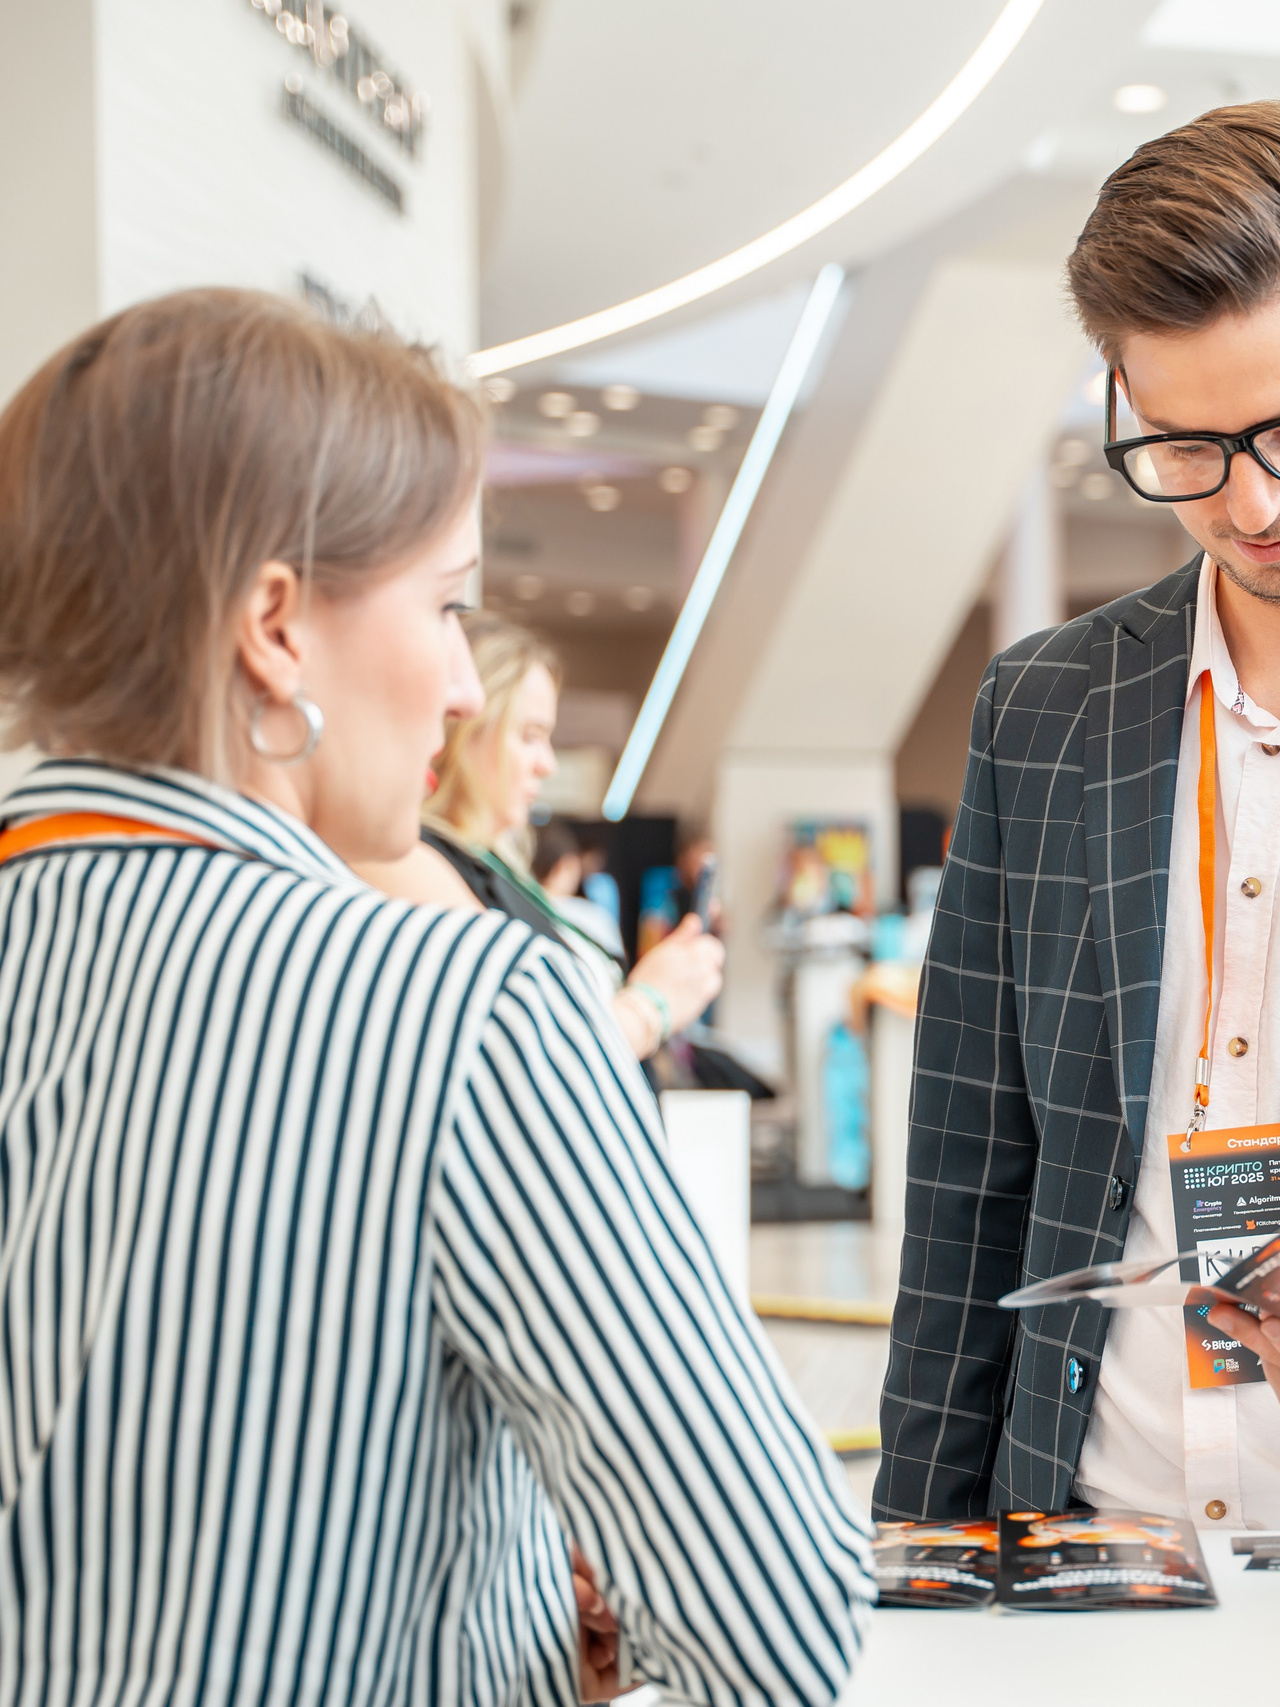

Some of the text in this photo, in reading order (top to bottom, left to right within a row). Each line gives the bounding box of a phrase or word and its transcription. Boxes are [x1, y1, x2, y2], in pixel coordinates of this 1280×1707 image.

[1207, 1161, 1262, 1176] КРИПТО
[1208, 1172, 1265, 1187] ЮГ 2025
[1204, 1200, 1222, 1208] Crypto
